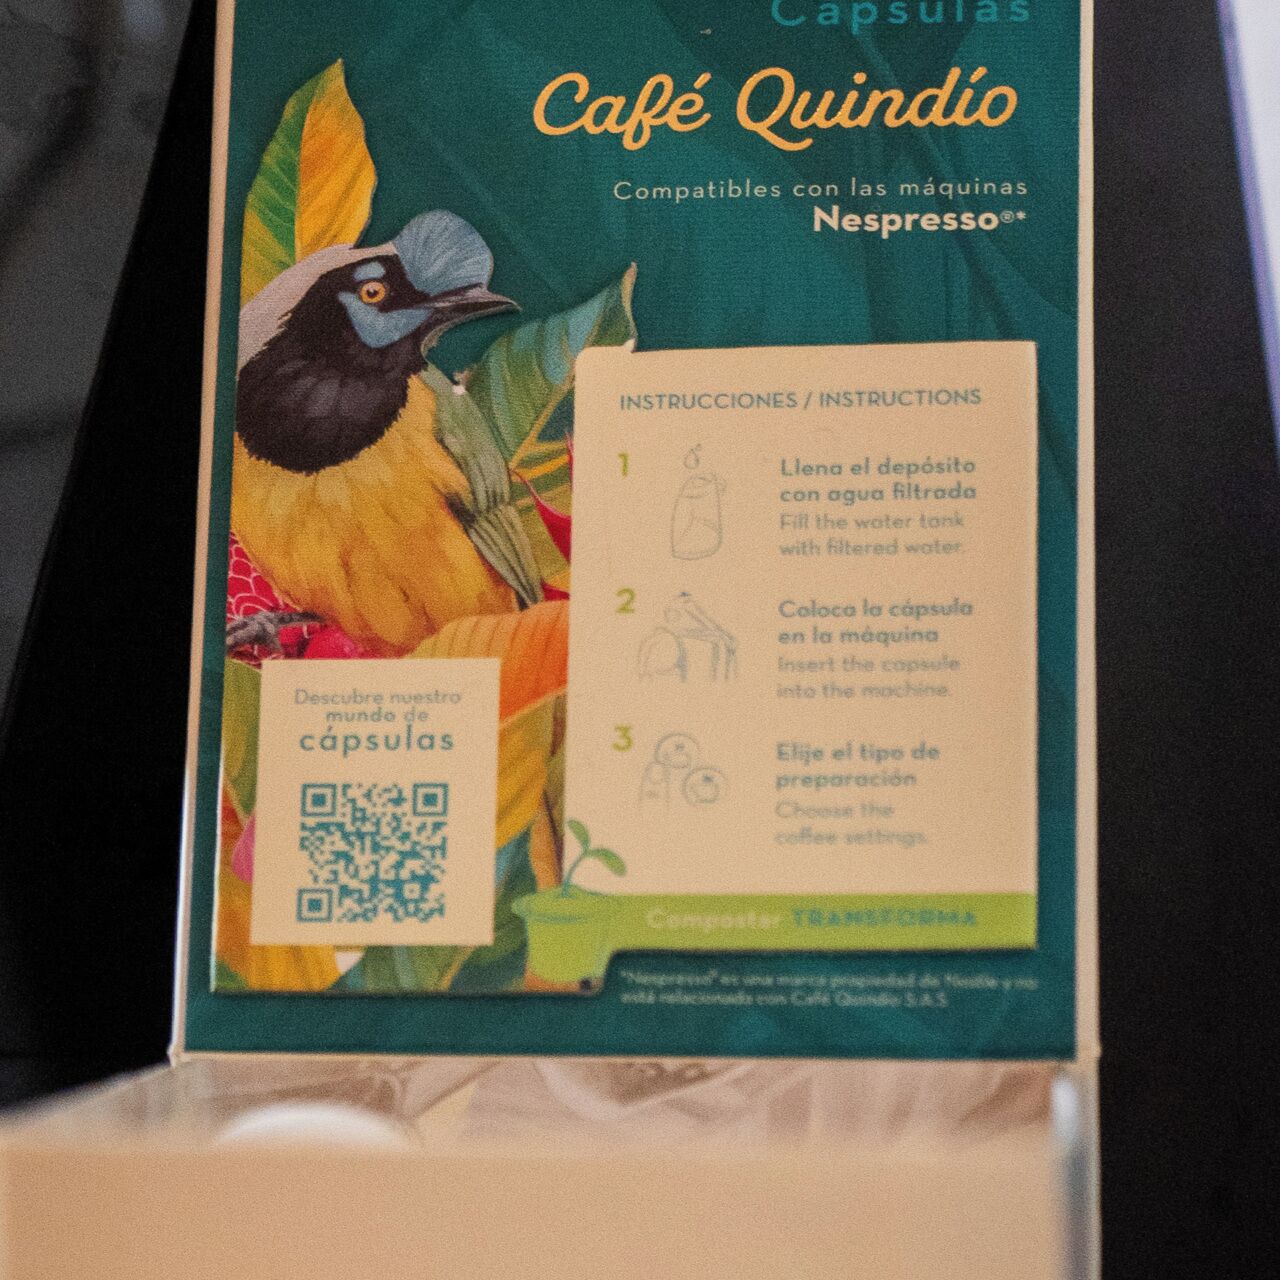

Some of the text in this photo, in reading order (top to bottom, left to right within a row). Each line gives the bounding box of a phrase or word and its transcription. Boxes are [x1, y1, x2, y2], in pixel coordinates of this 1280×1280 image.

[534, 66, 1018, 152] Café Quindío
[614, 176, 1028, 201] Compatibles con las máquinas
[620, 392, 798, 411] INSTRUCCIONES
[820, 389, 982, 407] INSTRUCTIONS
[618, 453, 629, 477] 1
[781, 456, 975, 480] Llena el depósito
[780, 482, 977, 507] con agua filtrada
[780, 512, 964, 531] Fill the water tank
[779, 540, 820, 557] with
[826, 538, 898, 556] filtered
[616, 588, 635, 614] 2
[778, 597, 973, 621] Coloca la cápsula
[778, 625, 939, 647] en la máquina
[778, 655, 961, 676] Insert the capsule
[295, 688, 461, 705] Descubre nuestro
[777, 682, 816, 699] into
[821, 681, 854, 699] the
[326, 706, 429, 722] mundo de
[299, 724, 455, 757] cápsulas
[612, 725, 634, 752] 3
[776, 741, 940, 766] Elije el tipo de
[776, 769, 917, 792] preparación
[860, 801, 894, 819] the
